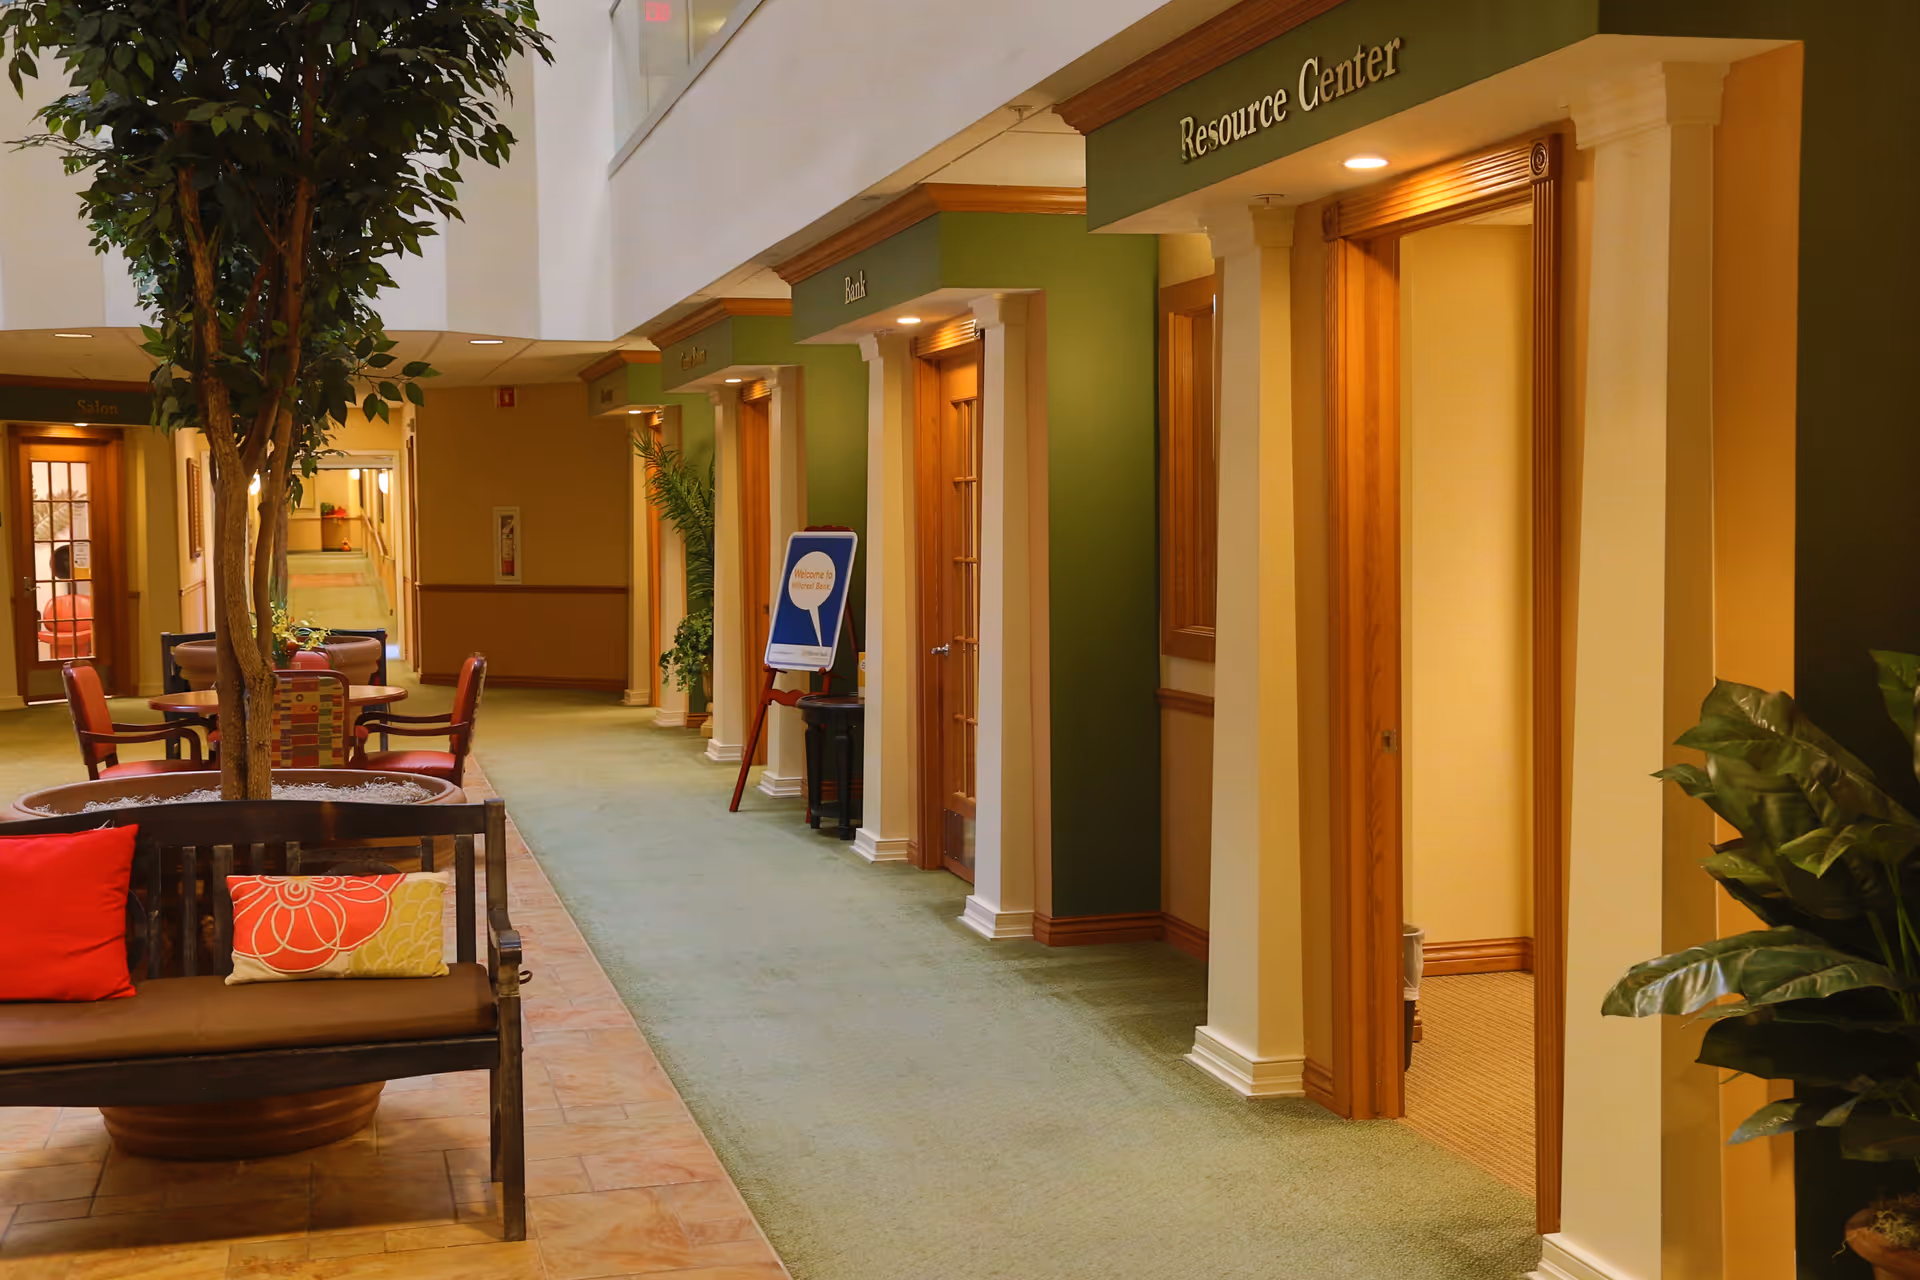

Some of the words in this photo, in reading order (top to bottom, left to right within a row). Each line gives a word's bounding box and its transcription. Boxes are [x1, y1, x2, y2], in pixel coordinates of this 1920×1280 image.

[1179, 88, 1287, 161] Resource
[1298, 37, 1401, 112] Center
[844, 270, 867, 304] Bank
[76, 399, 118, 415] Salon
[794, 569, 824, 579] Welcome
[826, 569, 833, 580] to
